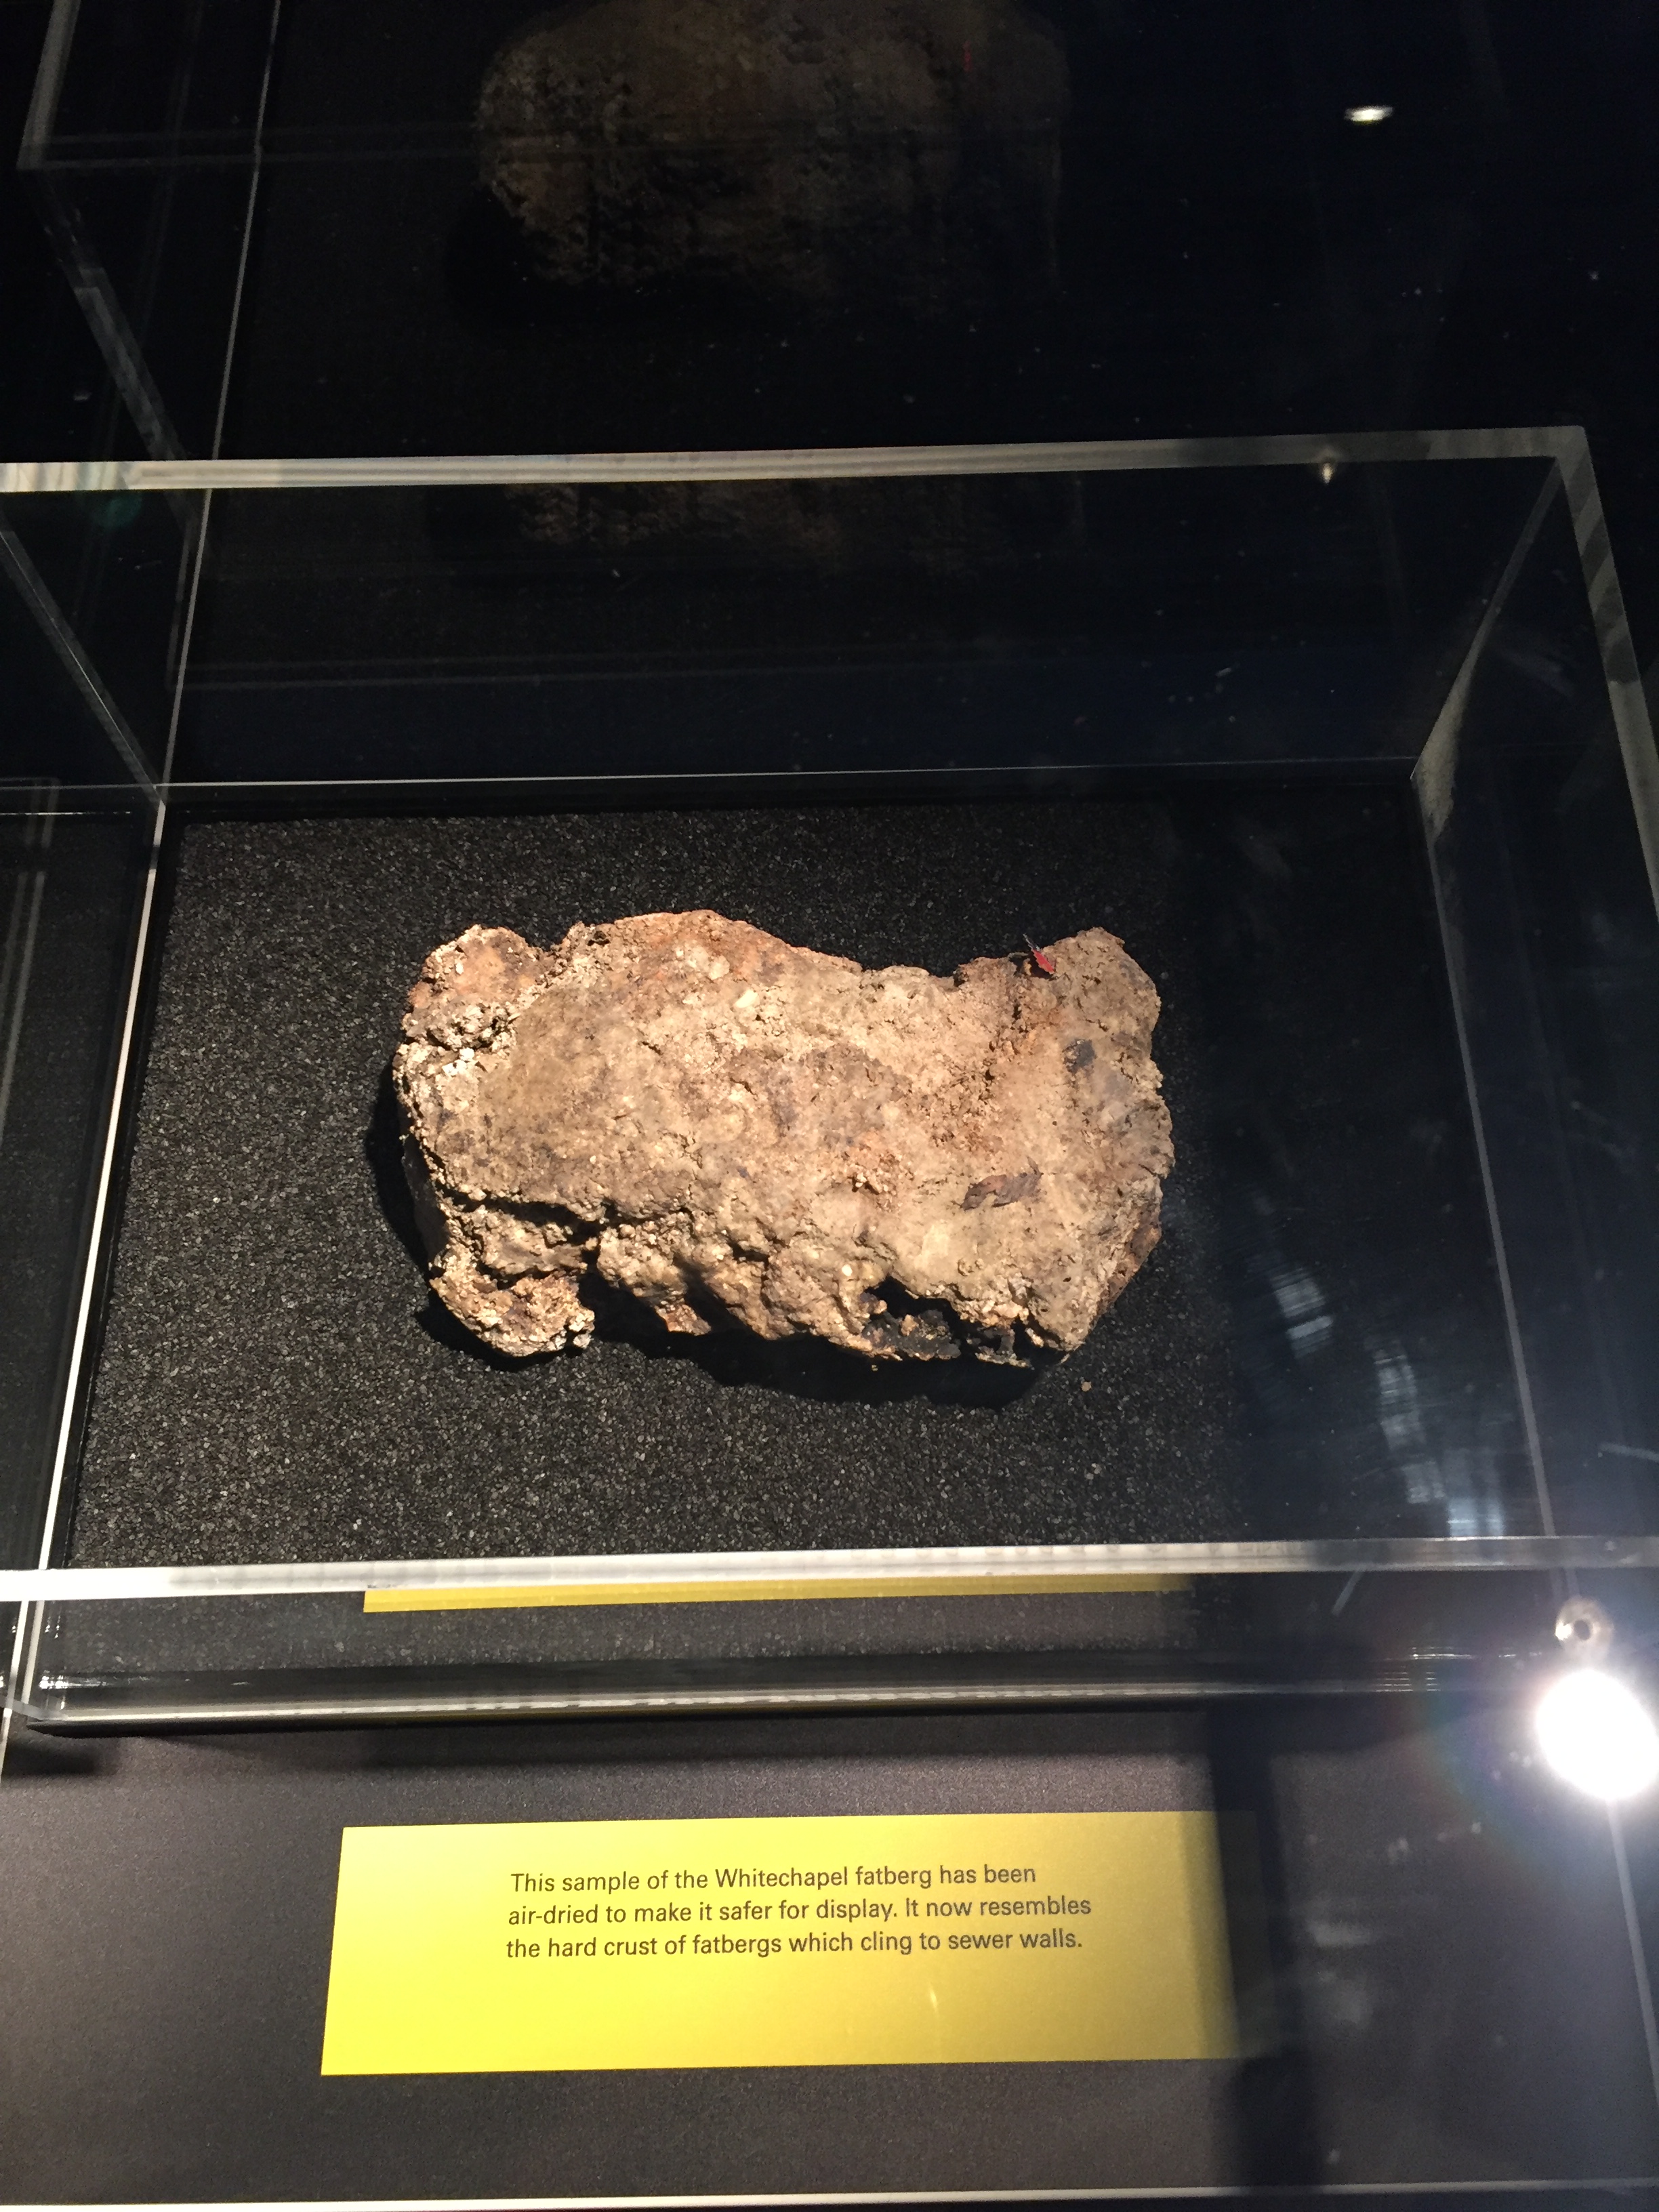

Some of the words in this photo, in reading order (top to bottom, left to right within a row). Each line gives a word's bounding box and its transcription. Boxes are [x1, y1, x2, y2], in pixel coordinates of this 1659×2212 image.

[510, 1872, 555, 1892] This
[562, 1870, 640, 1895] sample
[647, 1869, 669, 1890] of
[674, 1869, 708, 1889] the
[714, 1866, 848, 1891] Whitechapel
[855, 1865, 932, 1889] fatberg
[939, 1864, 977, 1884] has
[983, 1863, 1036, 1883] been
[508, 1904, 598, 1925] air-dried
[605, 1906, 627, 1923] to
[634, 1902, 692, 1923] make
[699, 1901, 713, 1921] it
[719, 1900, 773, 1921] safer
[778, 1899, 810, 1920] for
[816, 1898, 897, 1923] display.
[905, 1897, 920, 1917] It
[926, 1902, 972, 1917] now
[979, 1894, 1092, 1917] resembles
[506, 1938, 541, 1958] the
[548, 1936, 596, 1957] hard
[604, 1938, 658, 1957] crust
[664, 1934, 687, 1955] of
[692, 1933, 782, 1959] fatbergs
[788, 1931, 853, 1952] which
[861, 1931, 912, 1956] cling
[918, 1932, 941, 1950] to
[947, 1933, 1014, 1950] sewer
[1019, 1927, 1082, 1949] walls.
